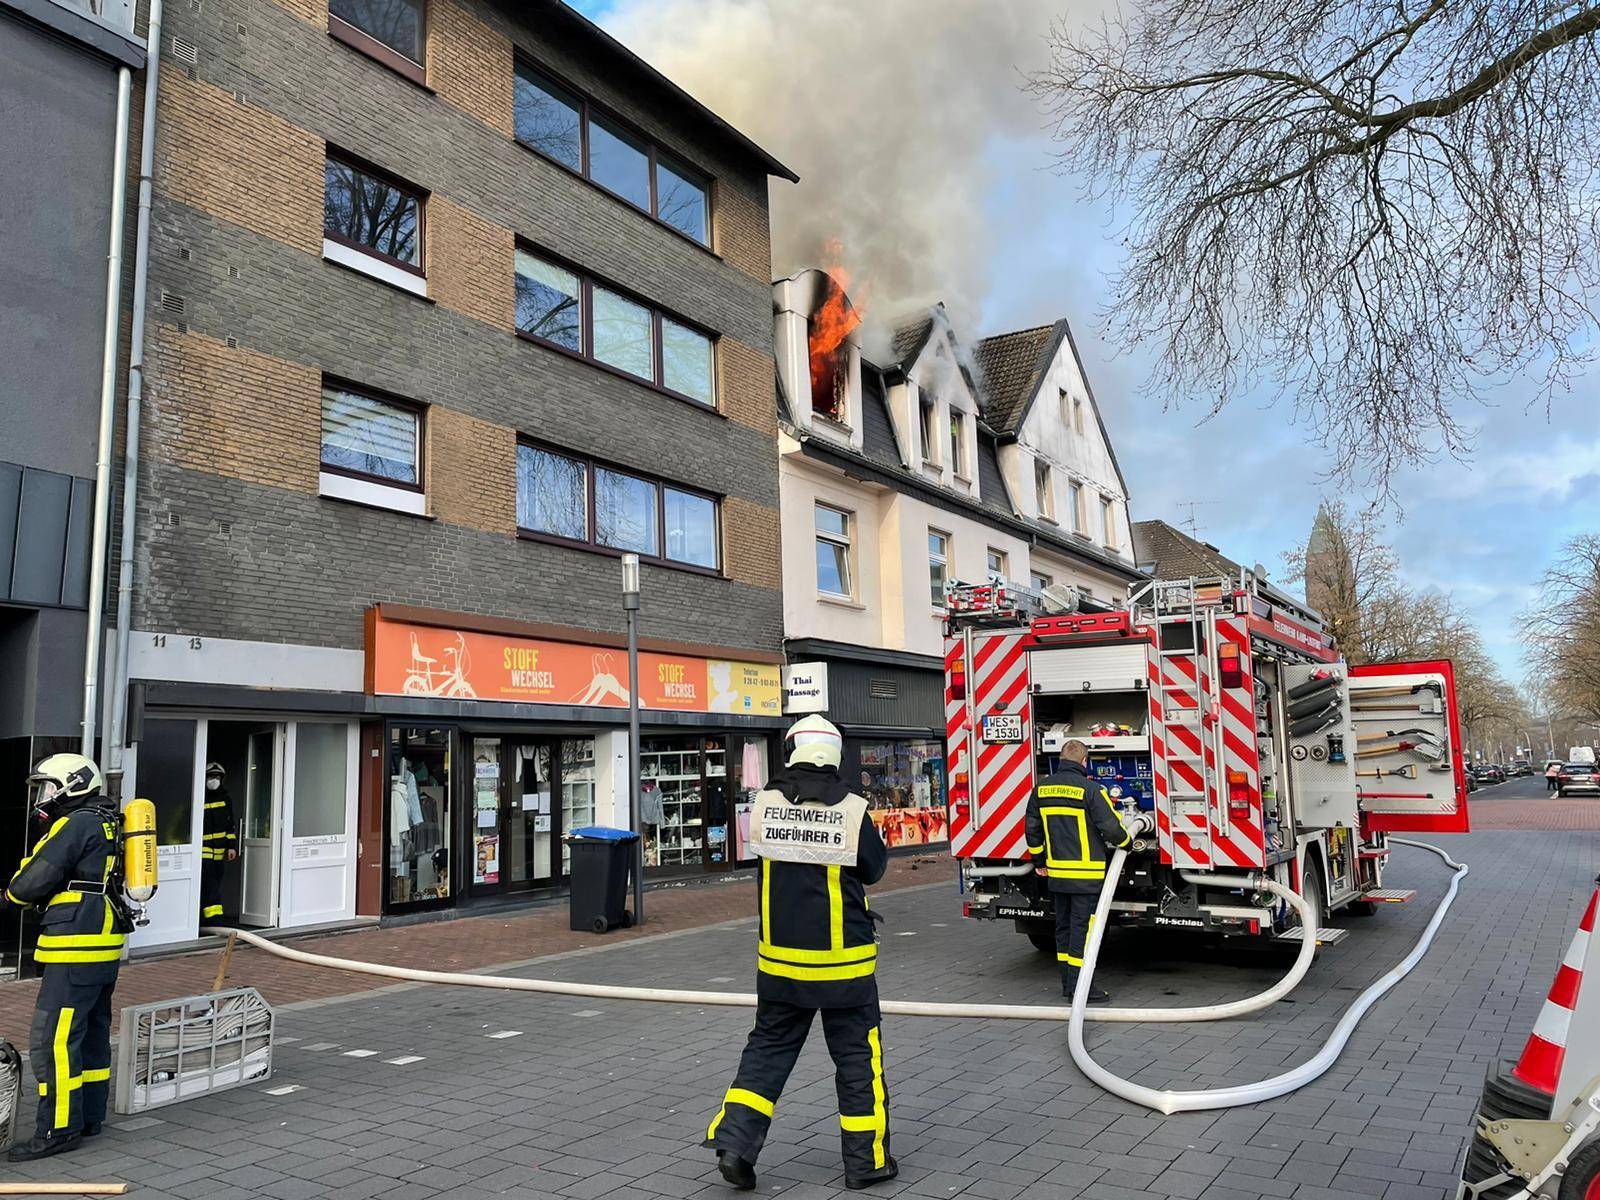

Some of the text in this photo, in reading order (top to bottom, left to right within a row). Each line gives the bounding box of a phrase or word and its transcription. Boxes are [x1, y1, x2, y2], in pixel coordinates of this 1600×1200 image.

[152, 634, 166, 648] 11
[188, 637, 202, 650] 13
[503, 647, 539, 670] STOFF
[511, 669, 555, 689] WECHSEL
[658, 663, 685, 683] STOFF
[792, 676, 812, 685] Thai
[664, 682, 697, 698] WECHSEL
[787, 688, 820, 697] Massage
[989, 717, 1008, 727] WES
[986, 728, 1019, 738] F 1530
[1039, 787, 1083, 797] FEUERWEHR
[764, 807, 843, 825] FEUERWEHR
[765, 826, 842, 844] ZUGFÜHRER 6
[144, 839, 153, 872] Atemluft
